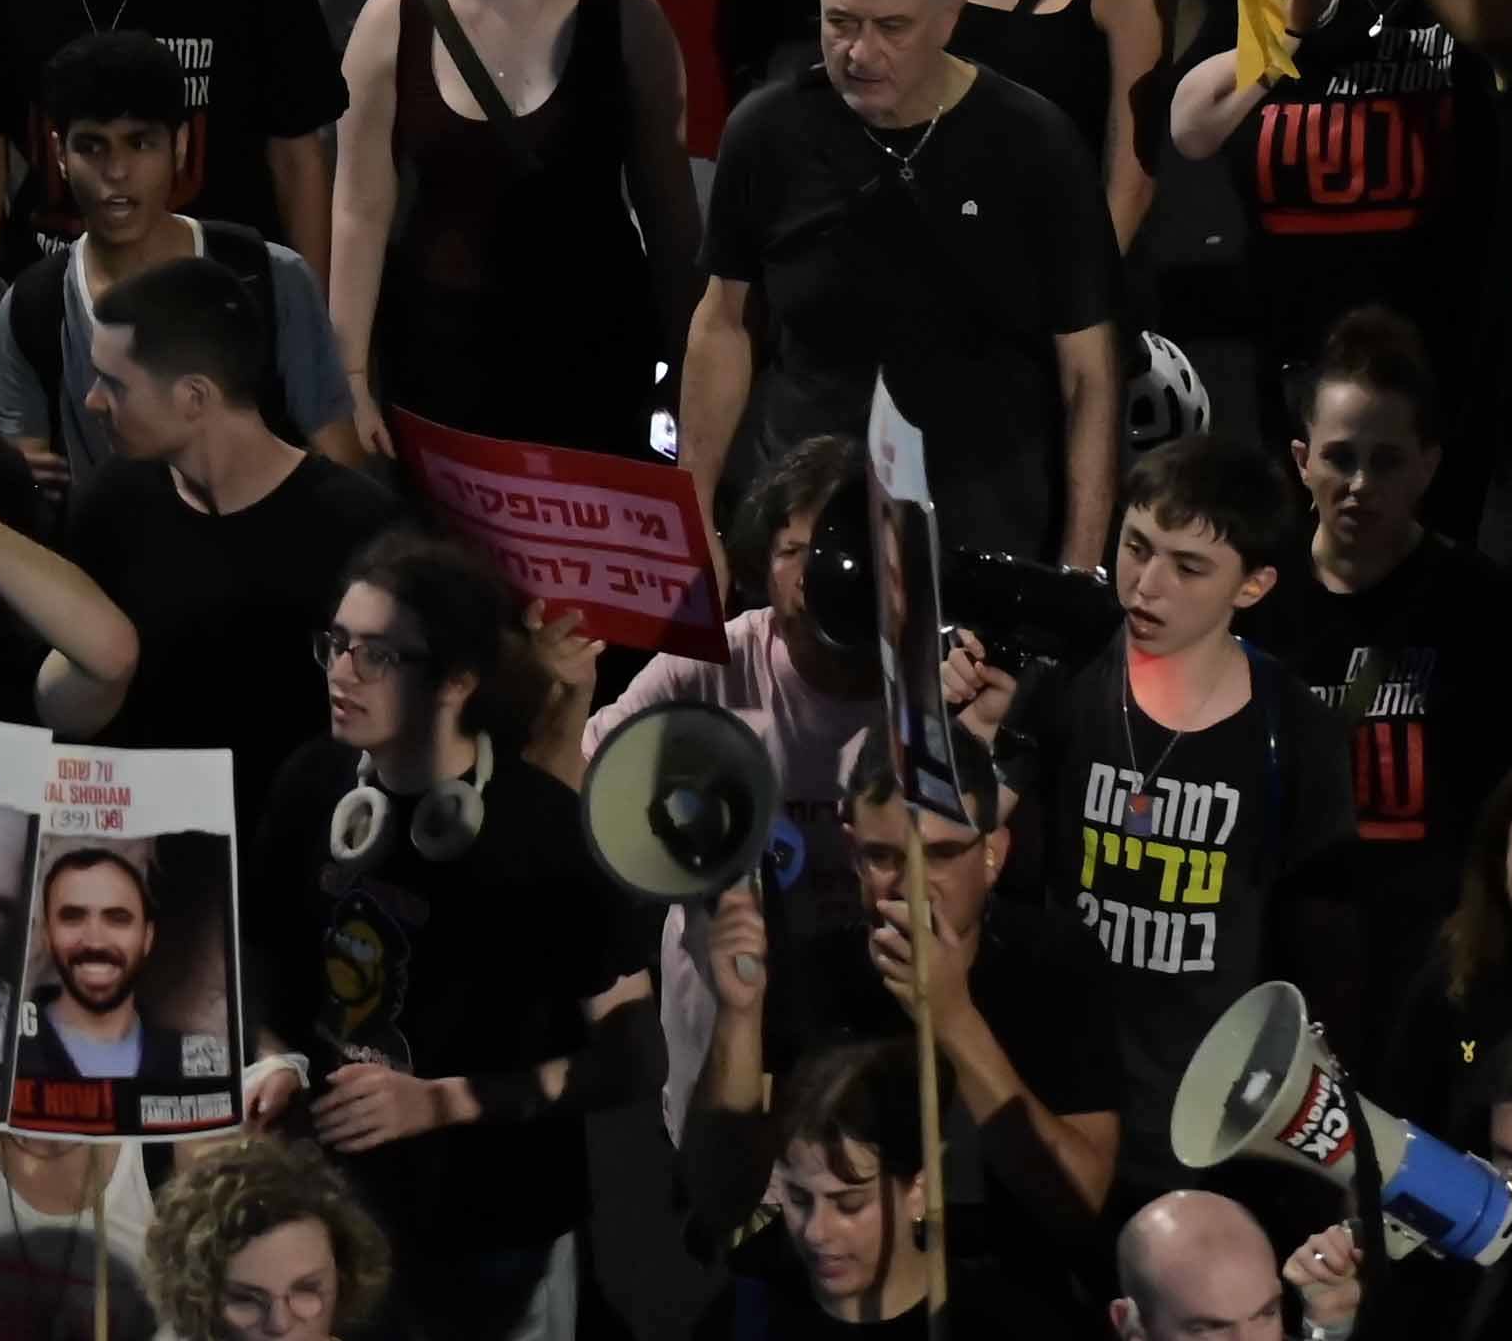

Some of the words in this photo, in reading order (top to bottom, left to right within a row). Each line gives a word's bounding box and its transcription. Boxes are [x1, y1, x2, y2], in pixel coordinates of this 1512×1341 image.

[621, 505, 668, 541] מי
[608, 563, 691, 604] חייב
[70, 787, 132, 807] SHOHAM
[1151, 775, 1241, 845] למה
[1080, 825, 1227, 904] עדיין
[1076, 891, 1216, 974] בעזה?
